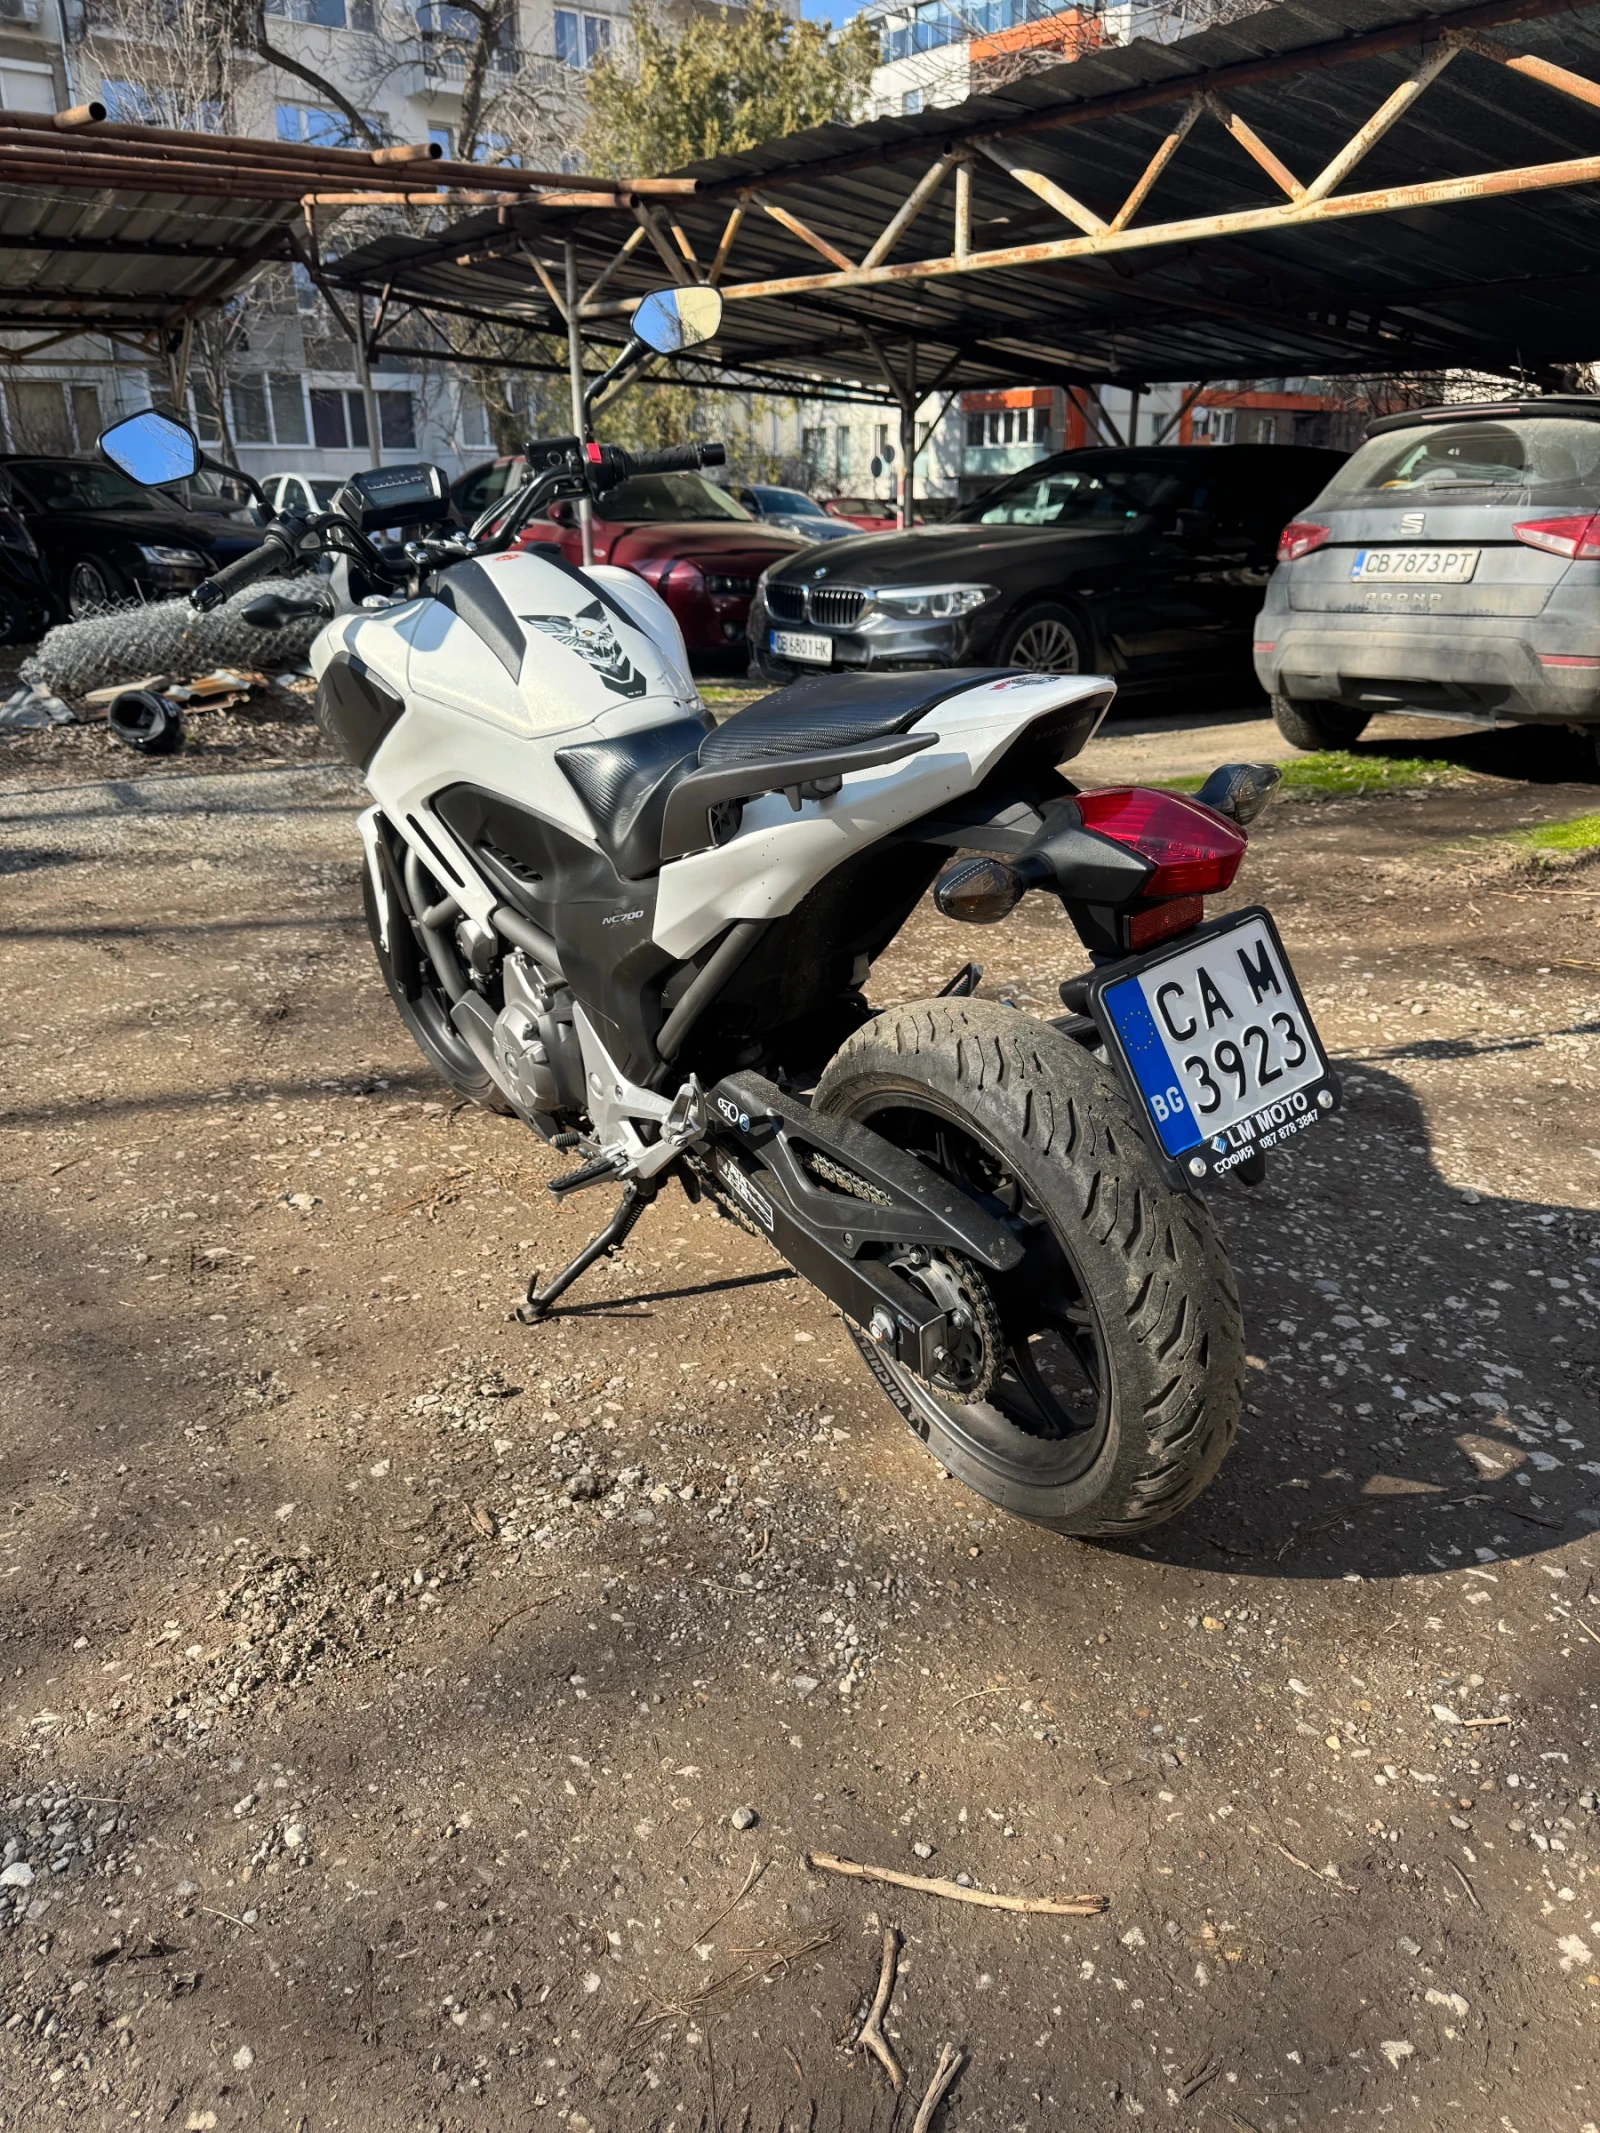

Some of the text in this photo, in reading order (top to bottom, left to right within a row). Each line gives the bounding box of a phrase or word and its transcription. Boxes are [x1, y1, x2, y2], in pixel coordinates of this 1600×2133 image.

[1392, 554, 1441, 573] 7873
[602, 910, 644, 925] NC700
[1156, 939, 1283, 1042] CA M
[1184, 1011, 1307, 1115] 3923
[1151, 1086, 1185, 1123] BG
[1226, 1091, 1309, 1148] LM MOTO
[1259, 1131, 1278, 1150] 087
[1212, 1145, 1255, 1175] СОФИЯ
[852, 1330, 910, 1409] MICHELI
